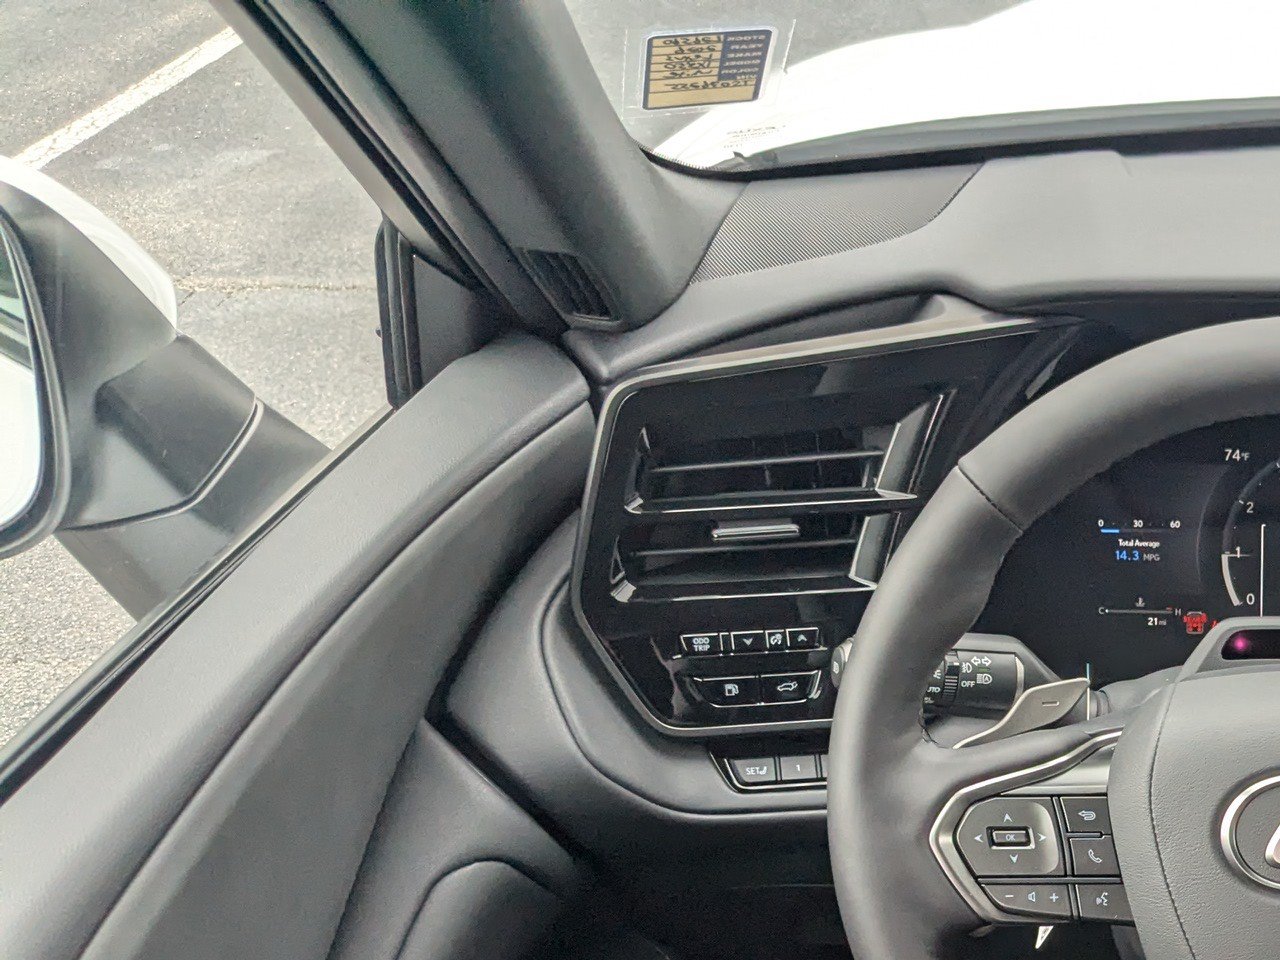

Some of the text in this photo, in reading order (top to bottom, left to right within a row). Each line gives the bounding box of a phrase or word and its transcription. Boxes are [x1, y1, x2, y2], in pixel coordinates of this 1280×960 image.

[1246, 502, 1254, 514] 2
[1098, 519, 1104, 528] 0
[1133, 520, 1144, 528] 30
[1170, 520, 1180, 528] 60
[1118, 538, 1160, 548] Total Average
[1114, 550, 1160, 562] 14.3 MPG
[1246, 592, 1254, 604] 0
[1174, 608, 1182, 616] H
[1148, 617, 1158, 626] 21
[693, 644, 710, 652] TRIP
[960, 680, 976, 688] OFF
[746, 766, 760, 775] SET
[1005, 834, 1016, 842] OK
